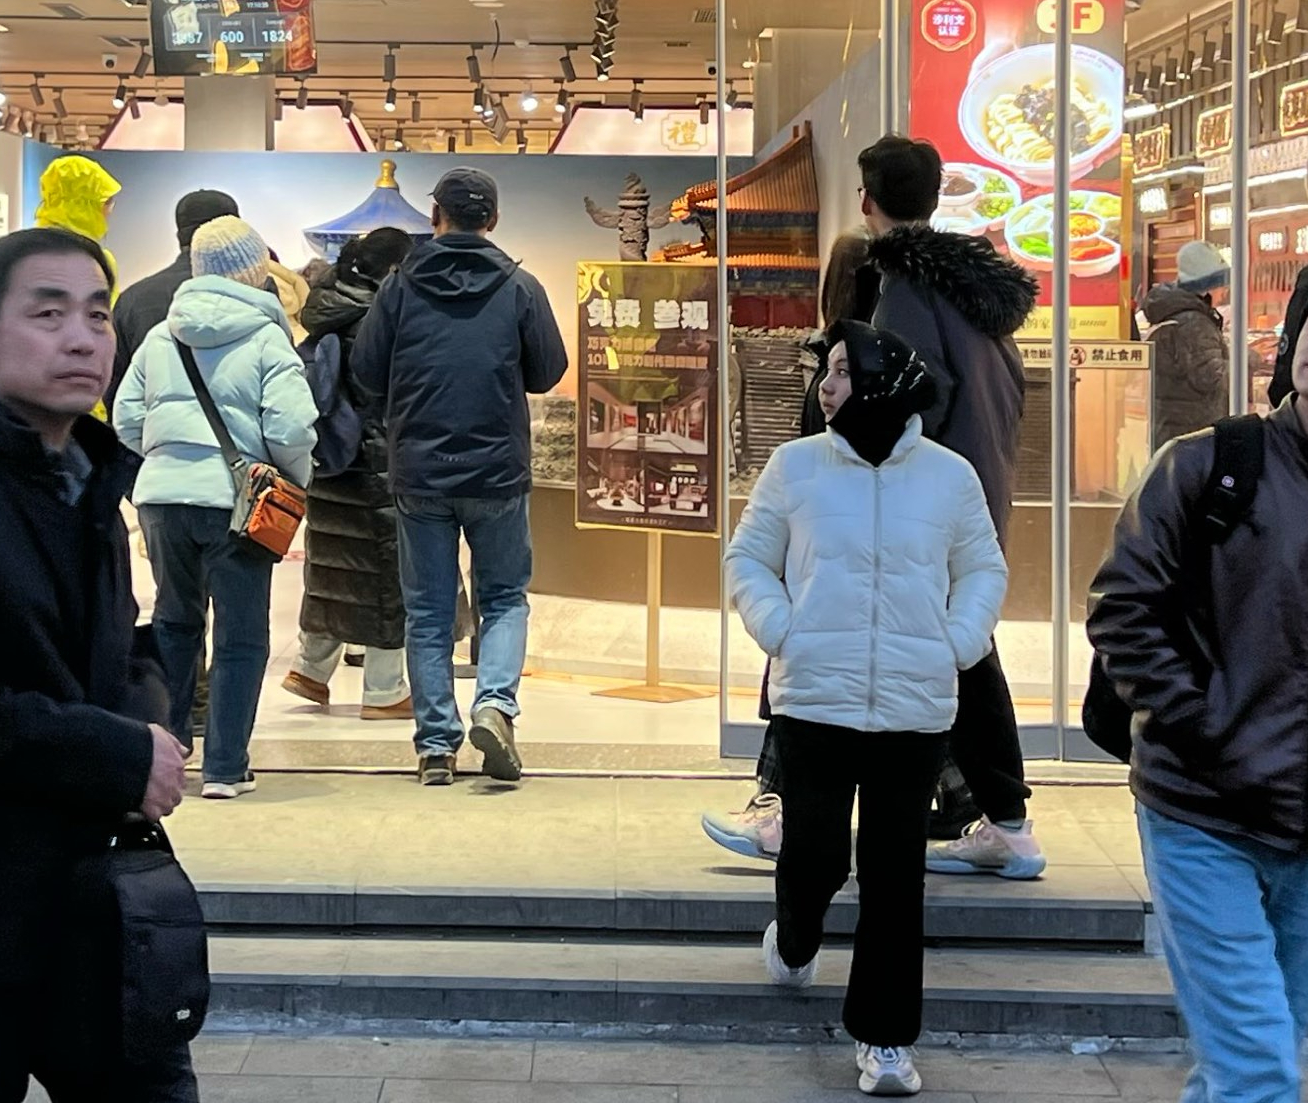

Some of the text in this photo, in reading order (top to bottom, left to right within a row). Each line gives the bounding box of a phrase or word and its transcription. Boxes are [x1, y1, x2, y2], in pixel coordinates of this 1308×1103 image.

[220, 31, 245, 44] 600
[261, 29, 293, 43] 1824
[1091, 348, 1143, 362] 禁止食用
